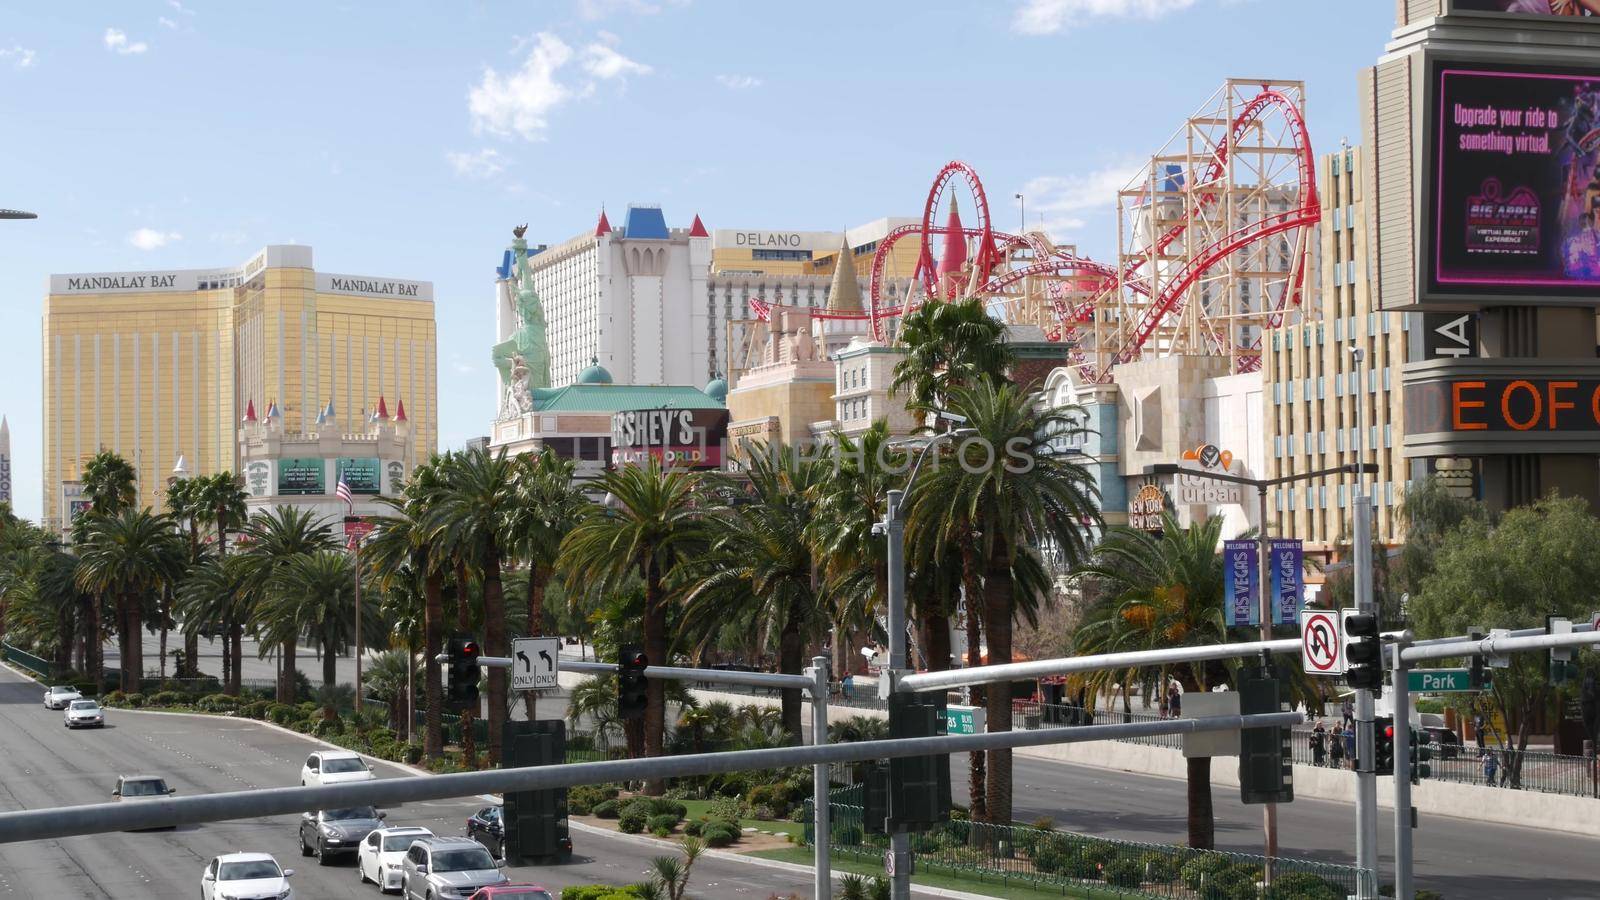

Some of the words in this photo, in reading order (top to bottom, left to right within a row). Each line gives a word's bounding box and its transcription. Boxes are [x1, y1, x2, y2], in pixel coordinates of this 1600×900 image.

[1454, 103, 1497, 127] Upgrade
[1500, 109, 1522, 128] your
[1525, 107, 1545, 128] ride
[1548, 110, 1558, 128] to
[1460, 130, 1513, 154] something
[1515, 131, 1551, 153] virtual.
[736, 232, 801, 247] DELANO
[68, 275, 147, 290] MANDALAY
[151, 274, 177, 288] BAY
[331, 278, 397, 294] MANDALAY
[398, 283, 419, 296] BAY
[1501, 379, 1579, 431] OF
[63, 488, 81, 497] LU
[1181, 485, 1241, 503] urban
[1128, 500, 1144, 514] NEW
[1145, 499, 1164, 512] YORK
[1128, 515, 1144, 528] NEW
[1233, 551, 1249, 595] VEGAS
[1280, 551, 1296, 594] VEGAS
[1235, 596, 1250, 622] LAS
[1282, 595, 1297, 621] LAS
[514, 675, 533, 685] ONLY
[536, 674, 556, 684] ONLY
[1422, 674, 1456, 689] Park
[947, 716, 957, 728] as
